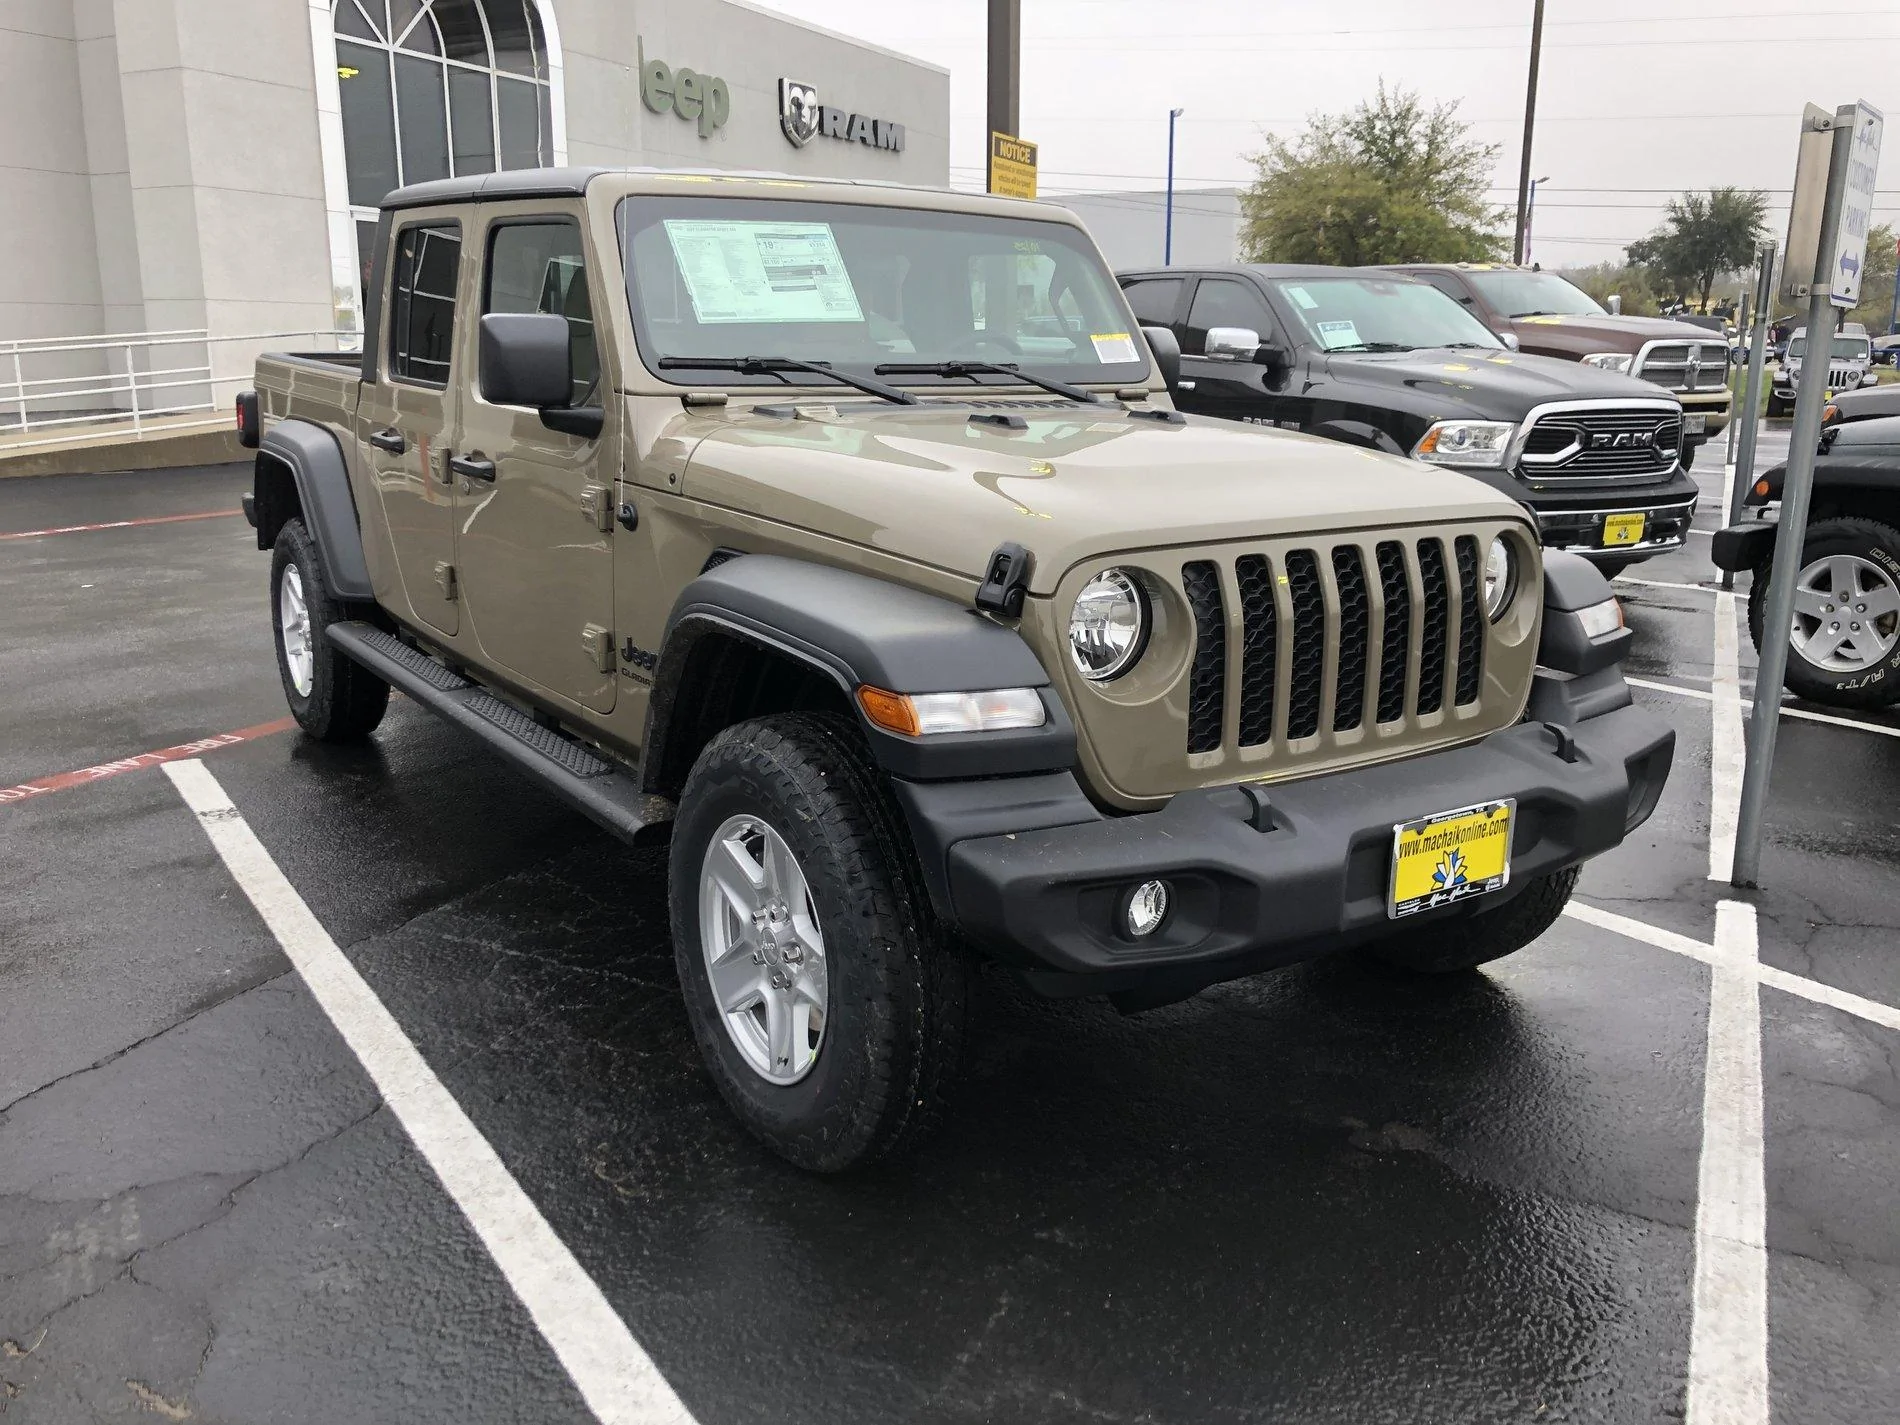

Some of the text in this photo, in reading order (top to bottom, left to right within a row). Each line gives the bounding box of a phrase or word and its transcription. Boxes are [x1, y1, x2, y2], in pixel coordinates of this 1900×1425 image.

[818, 105, 905, 152] RAM
[1000, 140, 1031, 164] NOTICE
[1591, 432, 1653, 448] RAM
[621, 667, 653, 686] GLADIA
[0, 734, 244, 801] FIRE LANE TO
